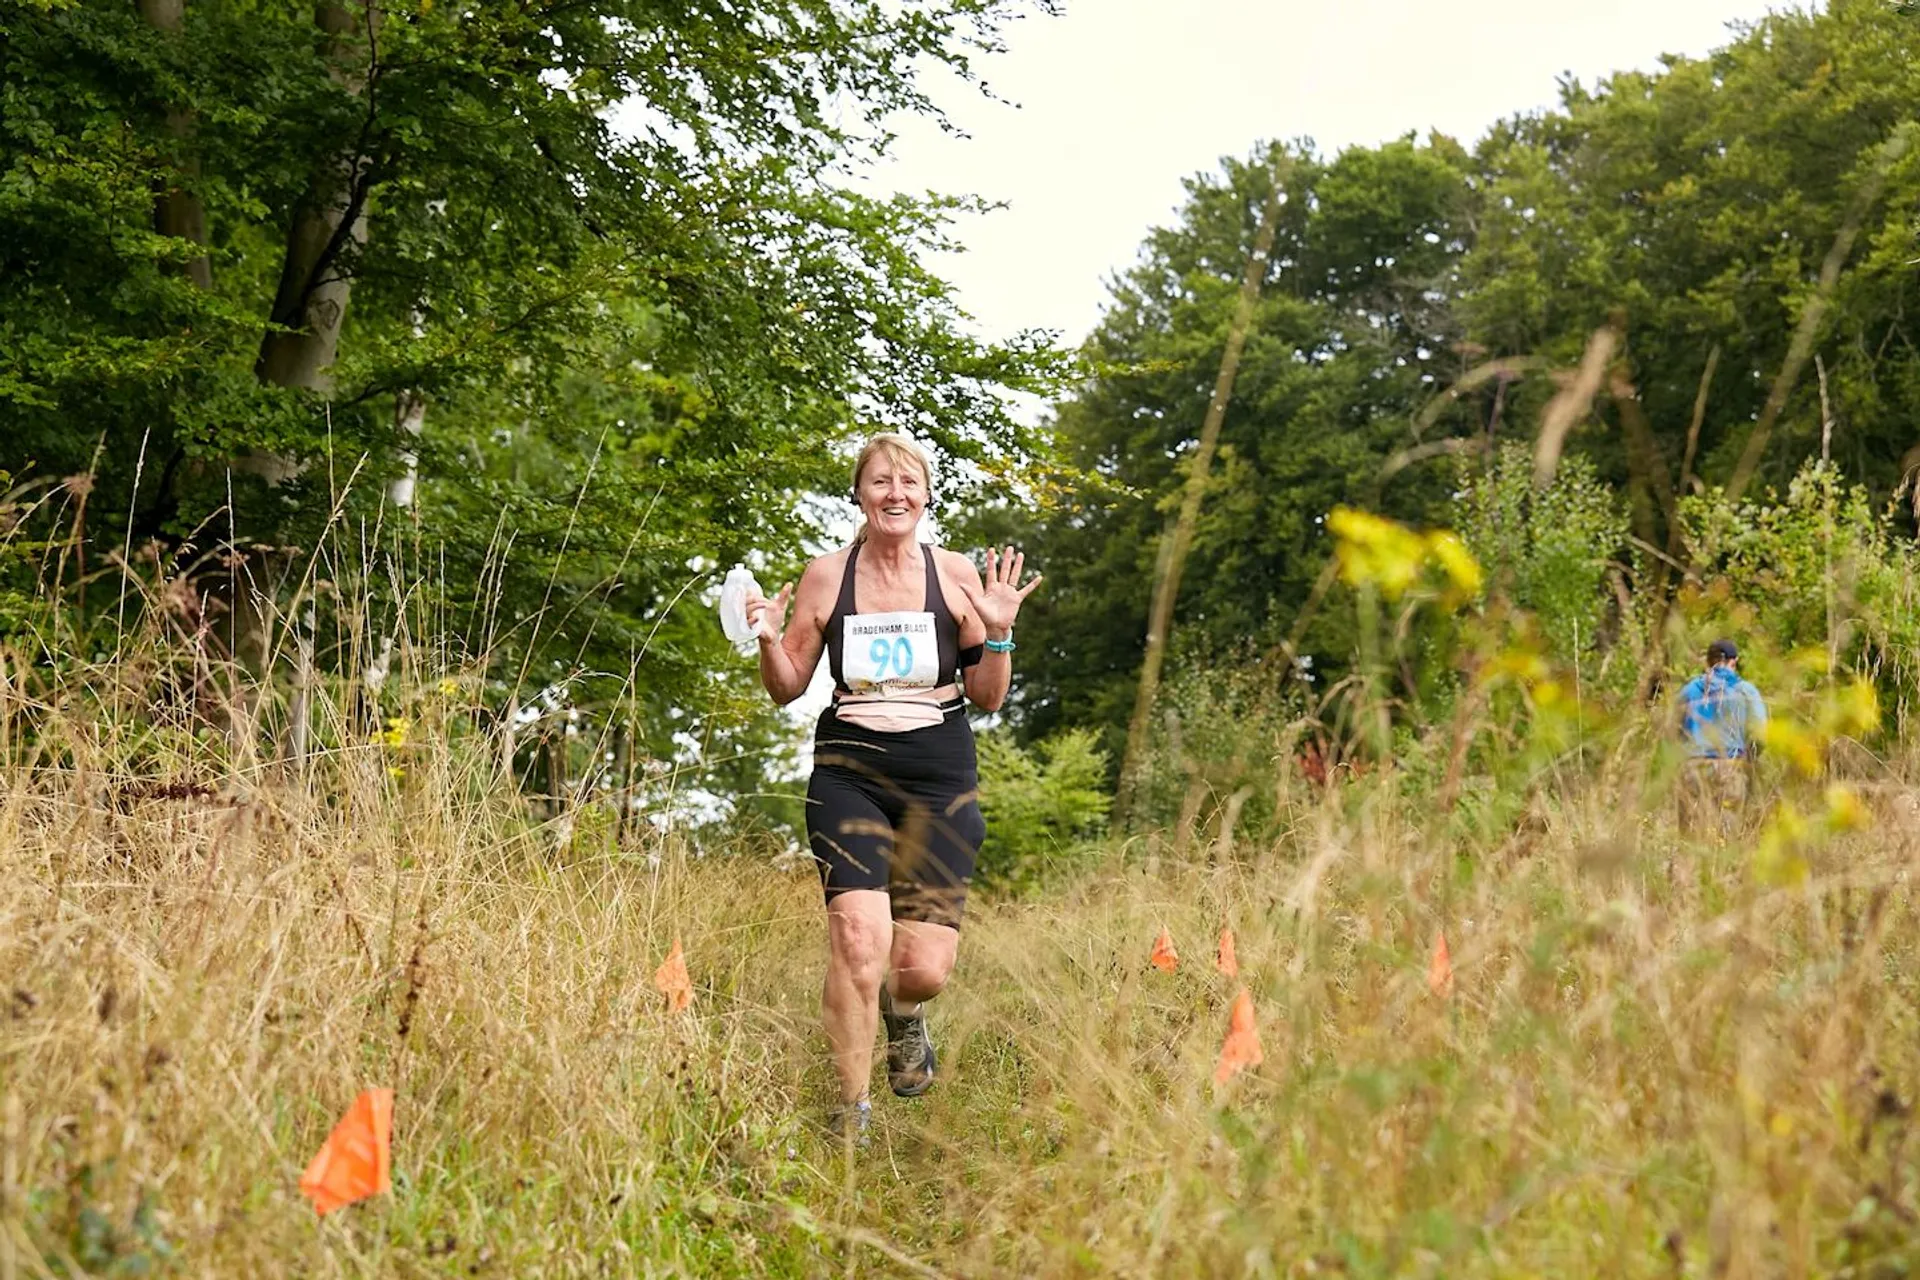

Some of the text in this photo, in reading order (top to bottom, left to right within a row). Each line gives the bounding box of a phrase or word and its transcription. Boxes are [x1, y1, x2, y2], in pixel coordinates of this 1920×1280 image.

[852, 623, 928, 635] BRADENHAM BLAST
[870, 637, 913, 677] 90
